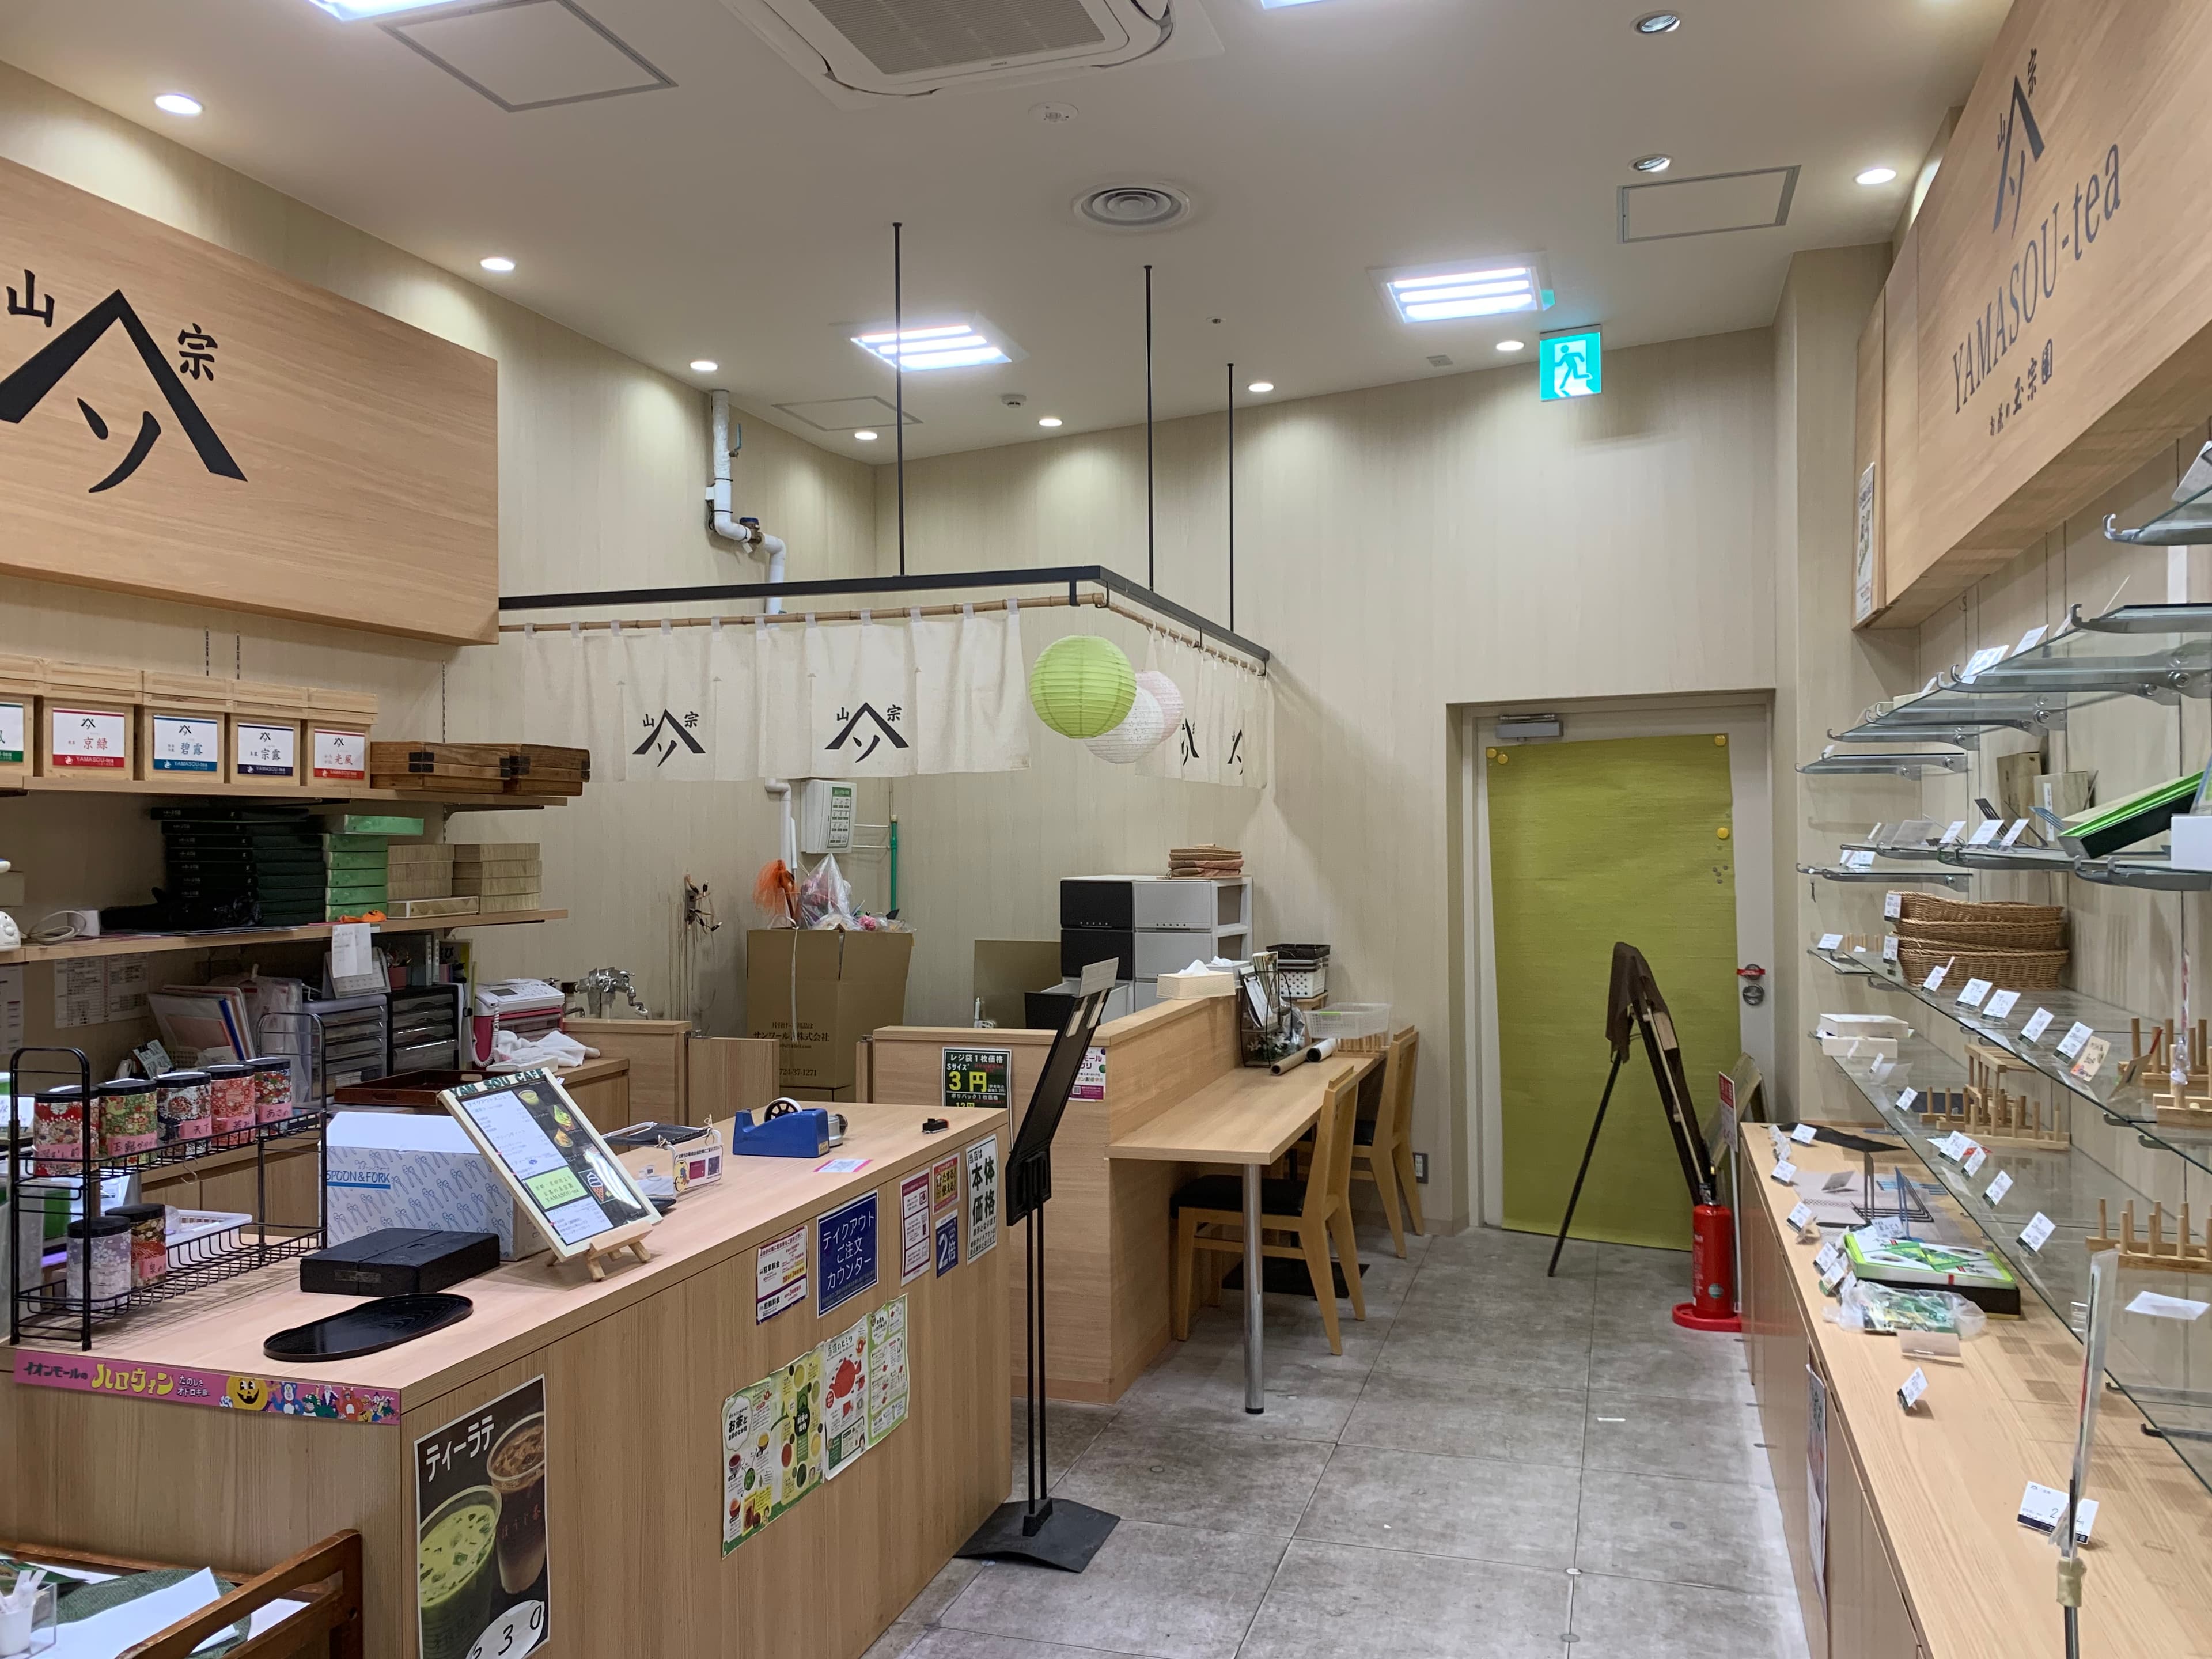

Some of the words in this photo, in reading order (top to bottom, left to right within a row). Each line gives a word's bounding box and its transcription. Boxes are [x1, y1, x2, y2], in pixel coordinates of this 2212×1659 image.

[2027, 47, 2038, 99] 宗
[1997, 112, 2006, 153] 山
[1951, 142, 2122, 415] YAMASOU-tea
[7, 268, 55, 328] 山
[177, 323, 219, 381] 宗
[642, 713, 654, 728] 山
[684, 711, 700, 729] 宗
[836, 706, 849, 722] 山
[886, 704, 902, 722] 宗
[753, 1032, 830, 1042] サンワール株式会社
[483, 1077, 510, 1090] SOU
[515, 1068, 544, 1083] CAFE
[972, 1156, 995, 1192] 本体
[972, 1189, 995, 1226] 価格
[823, 1210, 876, 1251] テイクアウト
[836, 1236, 863, 1264] ご注文
[827, 1257, 872, 1291] カウンター
[24, 1361, 88, 1380] イオンモールの
[91, 1363, 174, 1396] ハロウィン
[178, 1374, 203, 1387] たのしさ
[728, 1415, 748, 1434] お茶と
[426, 1414, 495, 1483] ティーラテ
